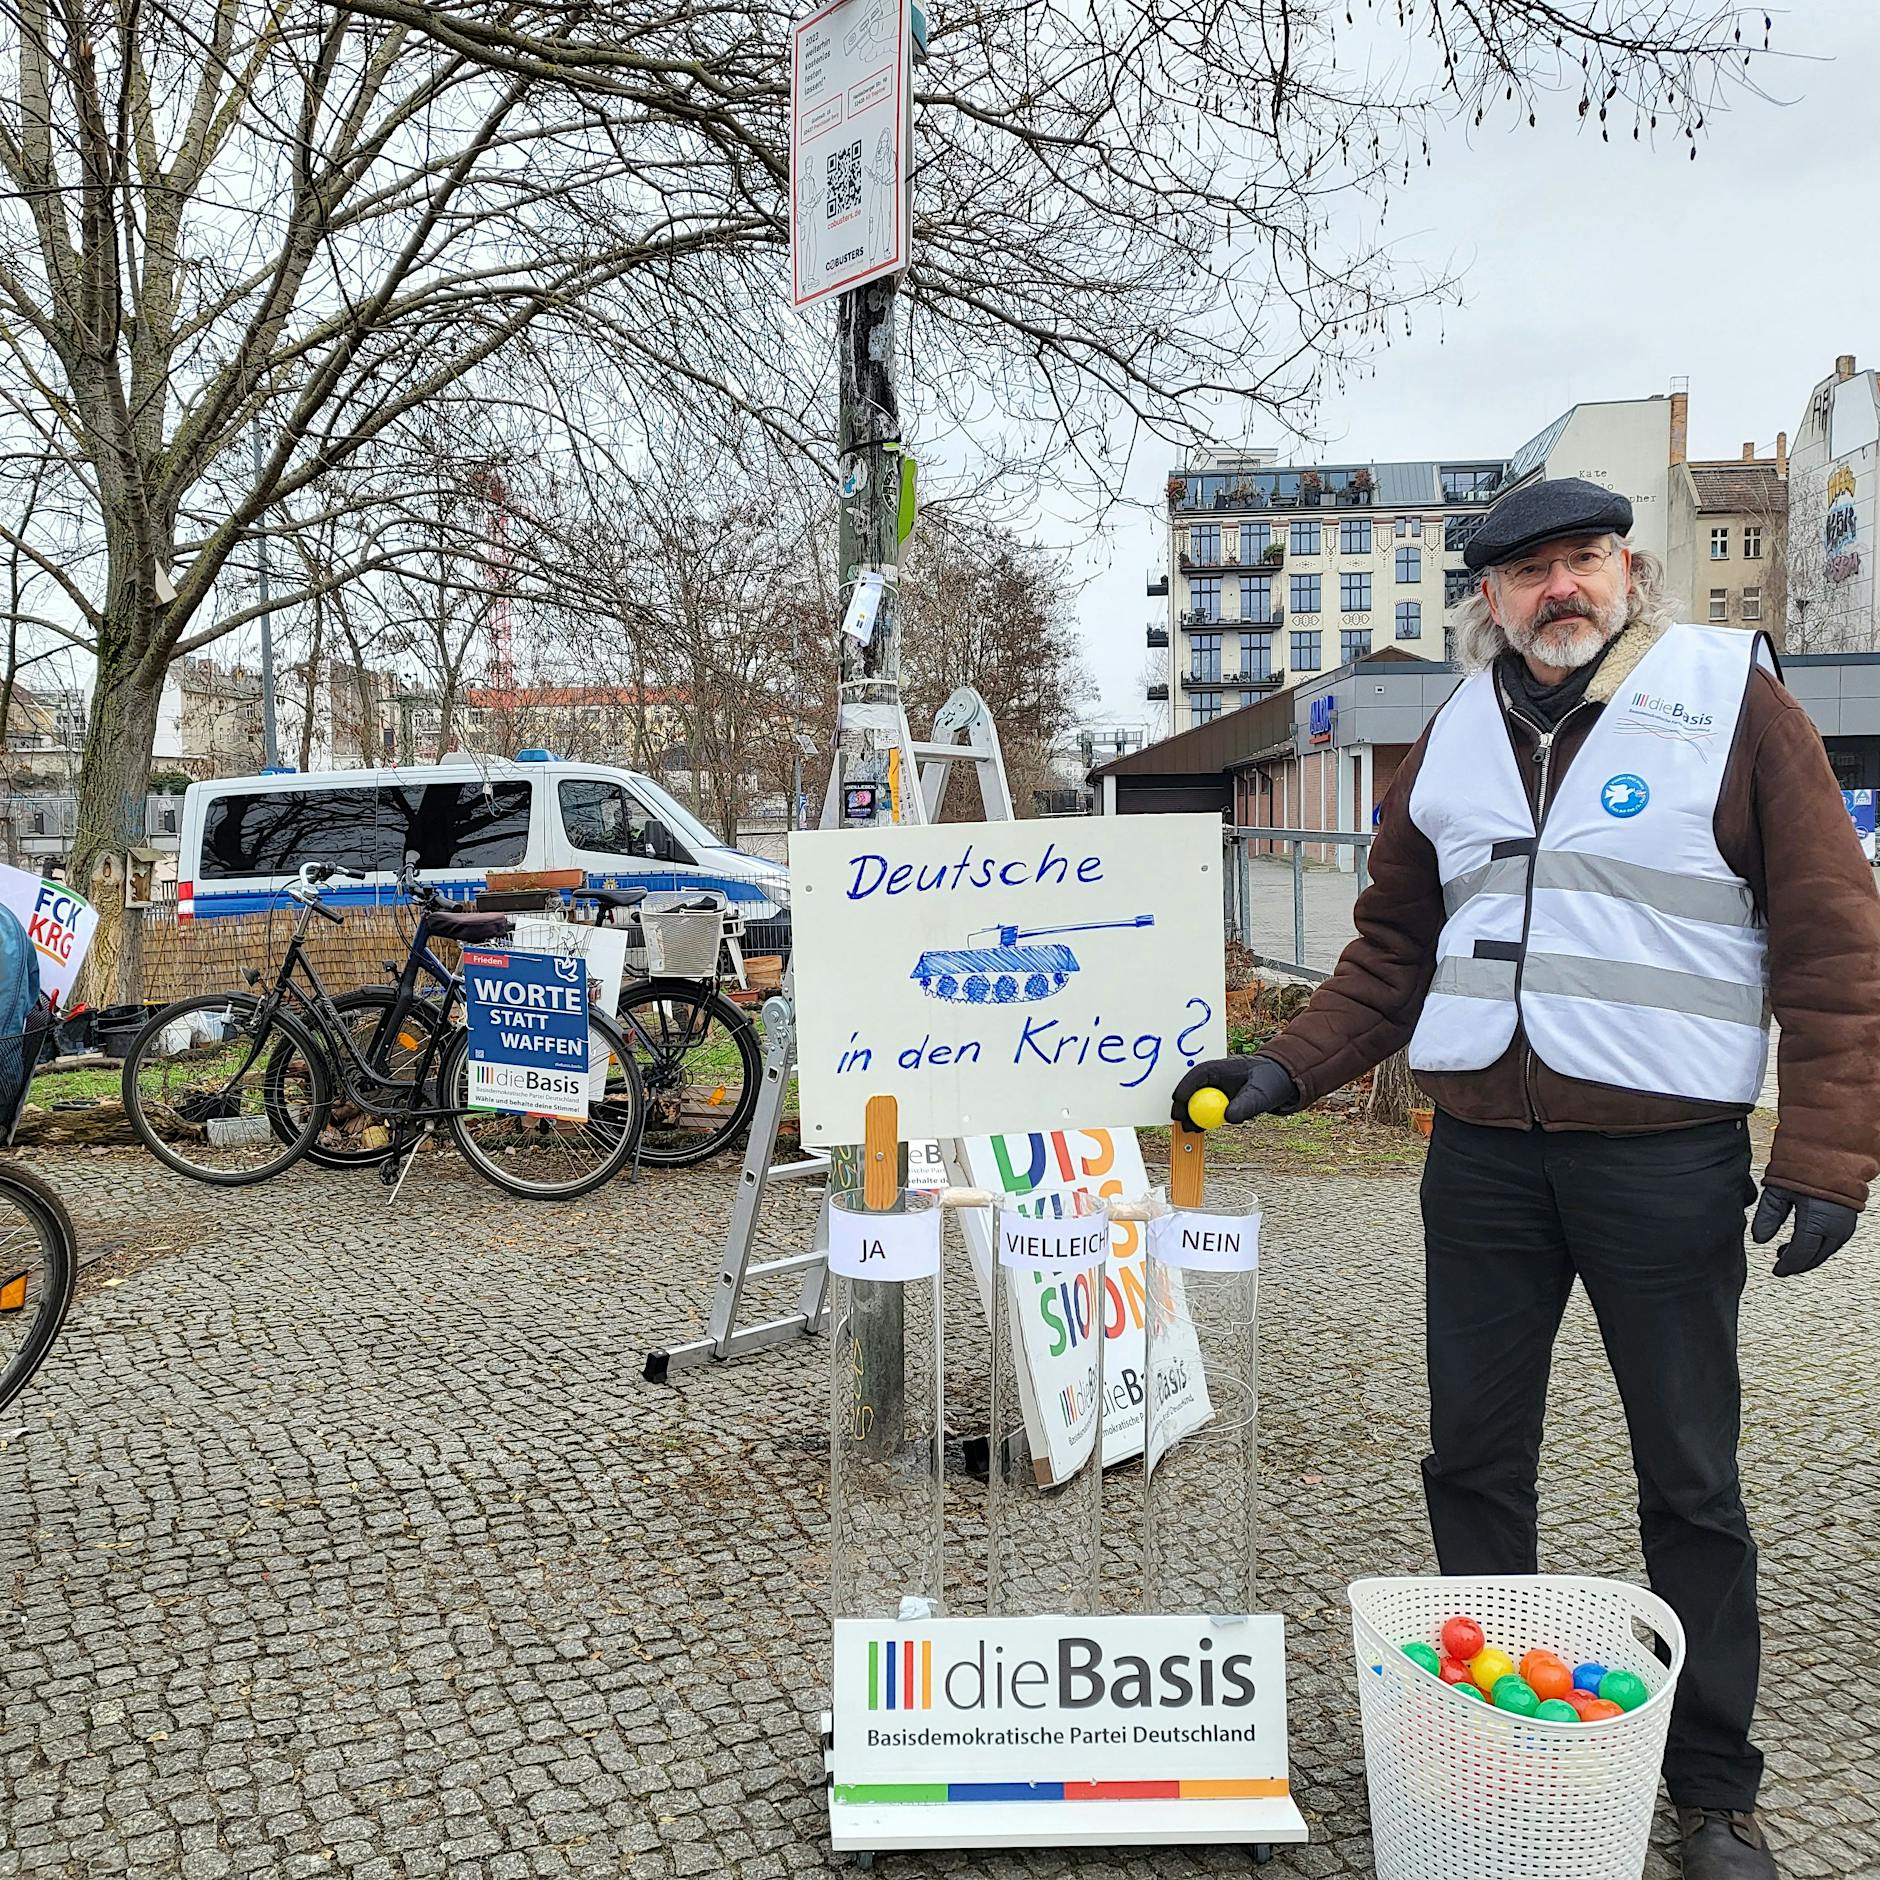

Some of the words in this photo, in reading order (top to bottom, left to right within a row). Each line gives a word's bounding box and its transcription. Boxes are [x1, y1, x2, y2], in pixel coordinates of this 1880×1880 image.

[805, 31, 819, 47] 2023
[805, 37, 831, 59] weiterhin
[805, 50, 831, 72] kostenlos
[804, 68, 822, 83] testen
[1648, 697, 1713, 725] dieBasis
[846, 843, 1105, 900] Deutsche
[34, 887, 82, 932] FCK
[28, 913, 75, 959] KRG
[473, 955, 503, 966] Frieden
[474, 978, 582, 1012] WORTE
[490, 1010, 549, 1030] STATT
[501, 1031, 582, 1056] WAFFEN
[836, 1031, 872, 1074] in
[898, 1034, 981, 1070] den
[1013, 997, 1212, 1087] Krieg?
[496, 1069, 580, 1095] dieBasis
[509, 1099, 533, 1108] behalte
[535, 1101, 552, 1109] deine
[859, 1238, 886, 1263] JA
[1182, 1229, 1242, 1255] NEIN
[944, 1637, 1256, 1711] dieBasis
[867, 1726, 1064, 1747] Basisdemokratische
[1070, 1725, 1127, 1744] Partei
[1134, 1723, 1256, 1744] Deutschland
